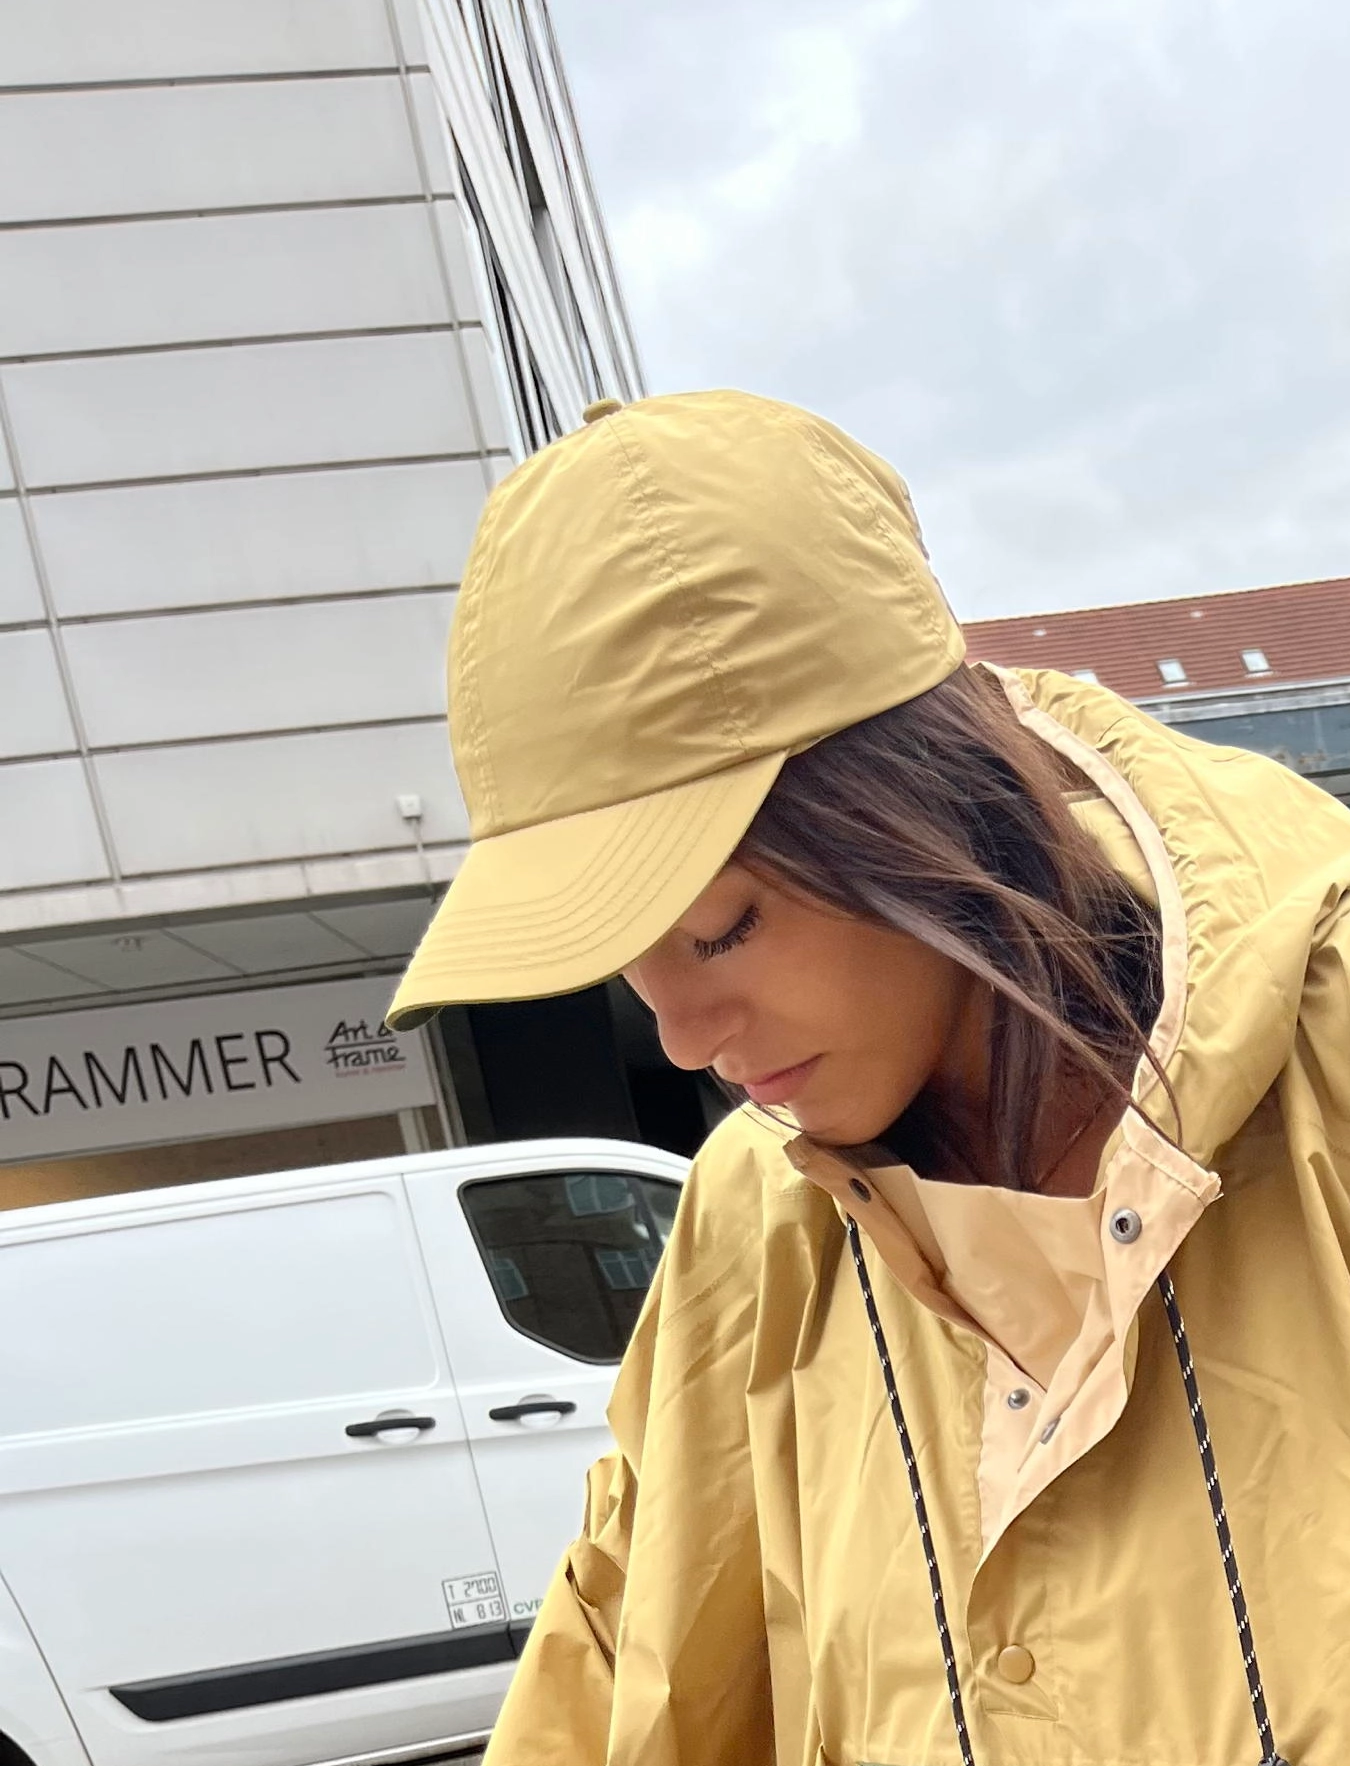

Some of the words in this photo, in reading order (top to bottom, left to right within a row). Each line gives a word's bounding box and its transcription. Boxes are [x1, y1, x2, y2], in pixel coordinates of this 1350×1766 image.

[328, 1019, 373, 1043] Art
[325, 1045, 407, 1068] Frame
[0, 1029, 302, 1118] RAMMER
[448, 1584, 455, 1600] T
